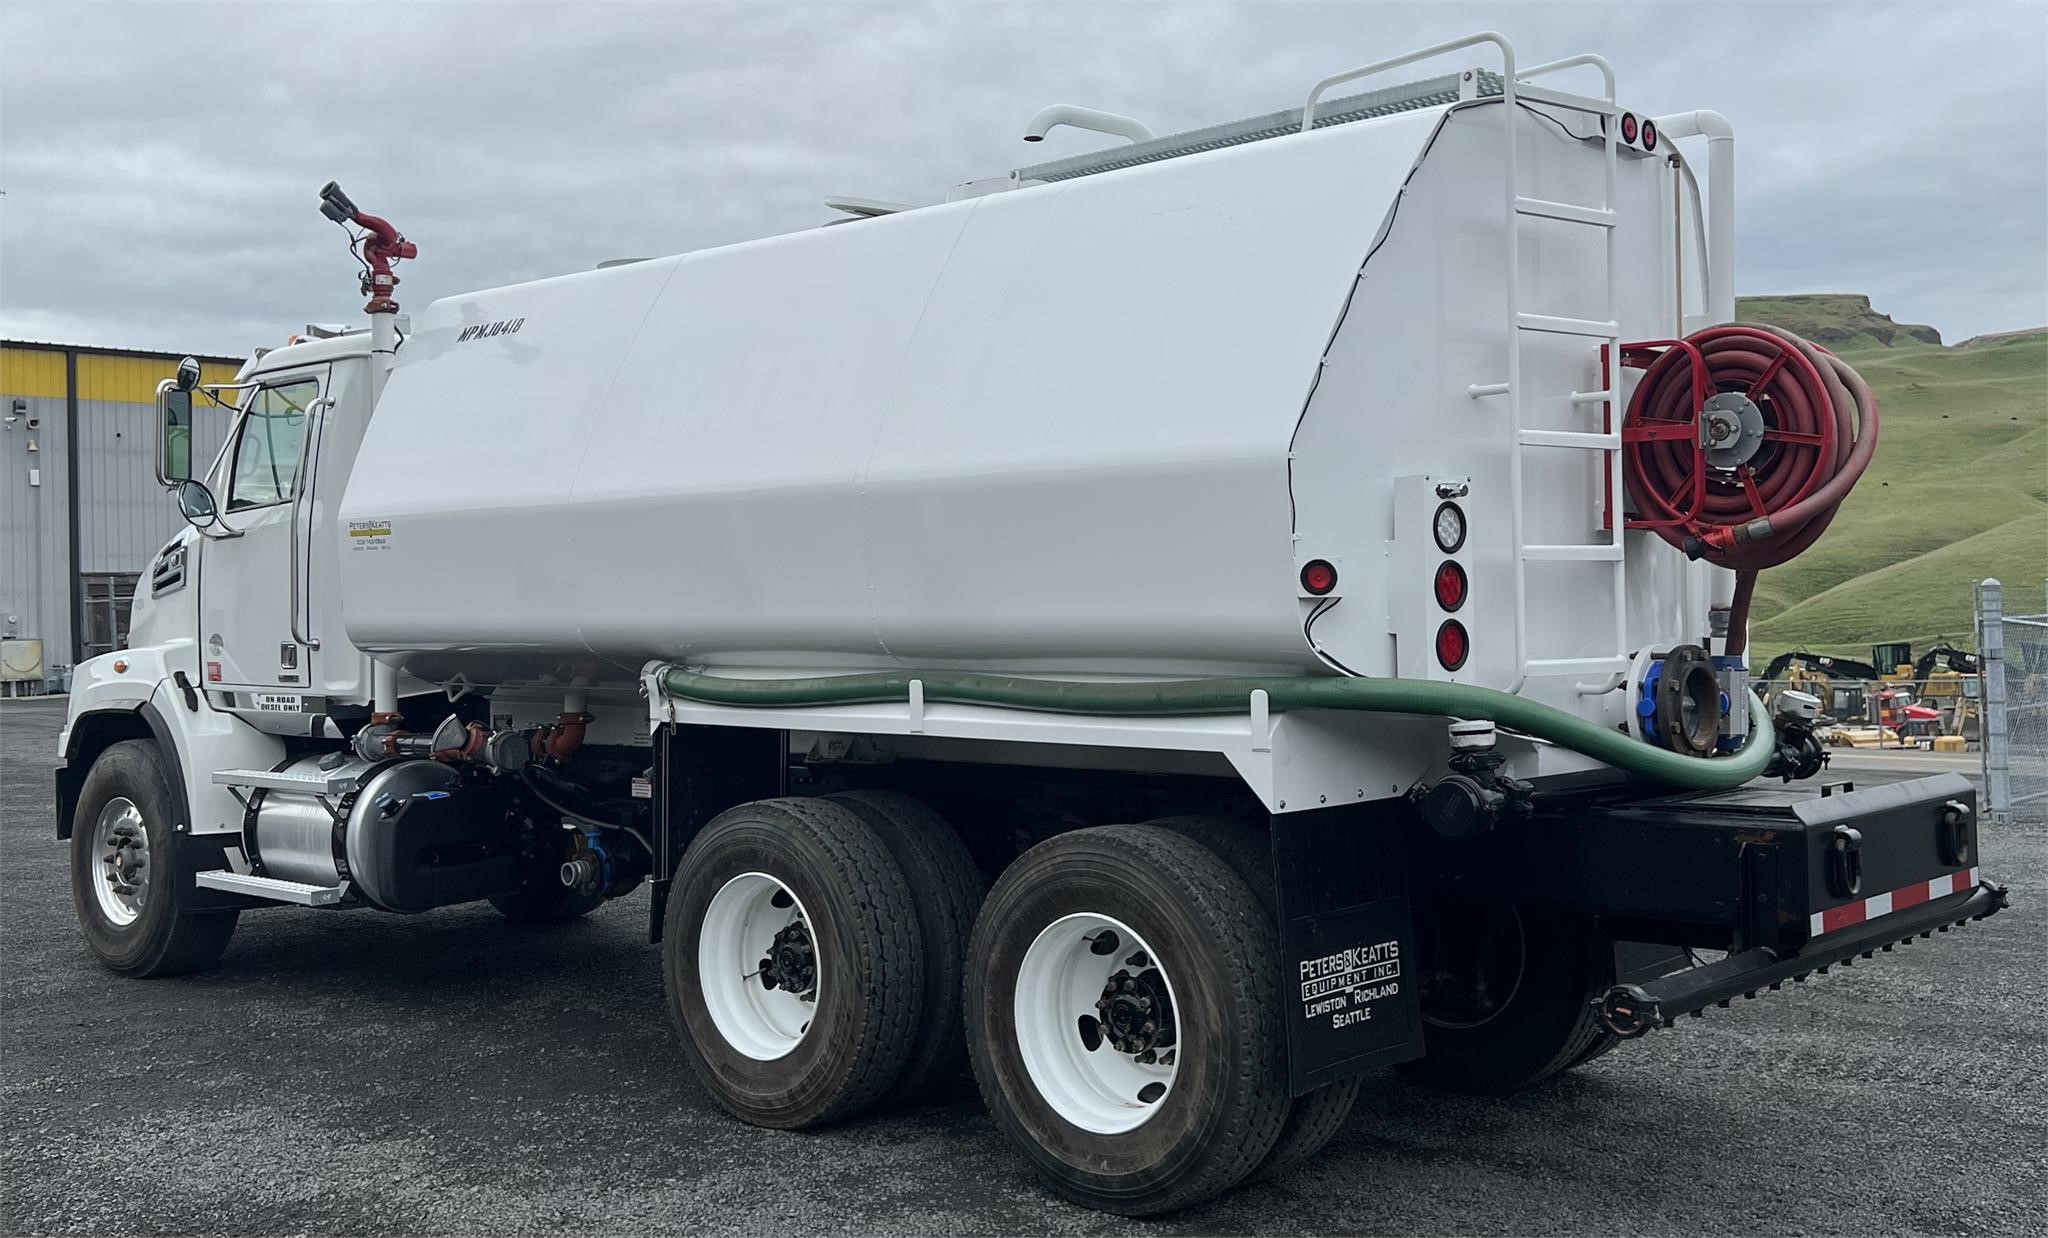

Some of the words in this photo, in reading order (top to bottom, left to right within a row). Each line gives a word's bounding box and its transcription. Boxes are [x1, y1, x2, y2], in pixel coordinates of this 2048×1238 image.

[260, 703, 281, 711] DIESEL
[283, 704, 301, 712] ONLY
[265, 695, 275, 703] ON
[276, 696, 296, 704] ROAD
[1304, 969, 1367, 997] EQUIPMENT
[1373, 963, 1397, 979] INC.
[1305, 995, 1347, 1019] LEWISTON
[1354, 982, 1399, 1005] RICHLAND
[1332, 1007, 1372, 1029] SEATTLE
